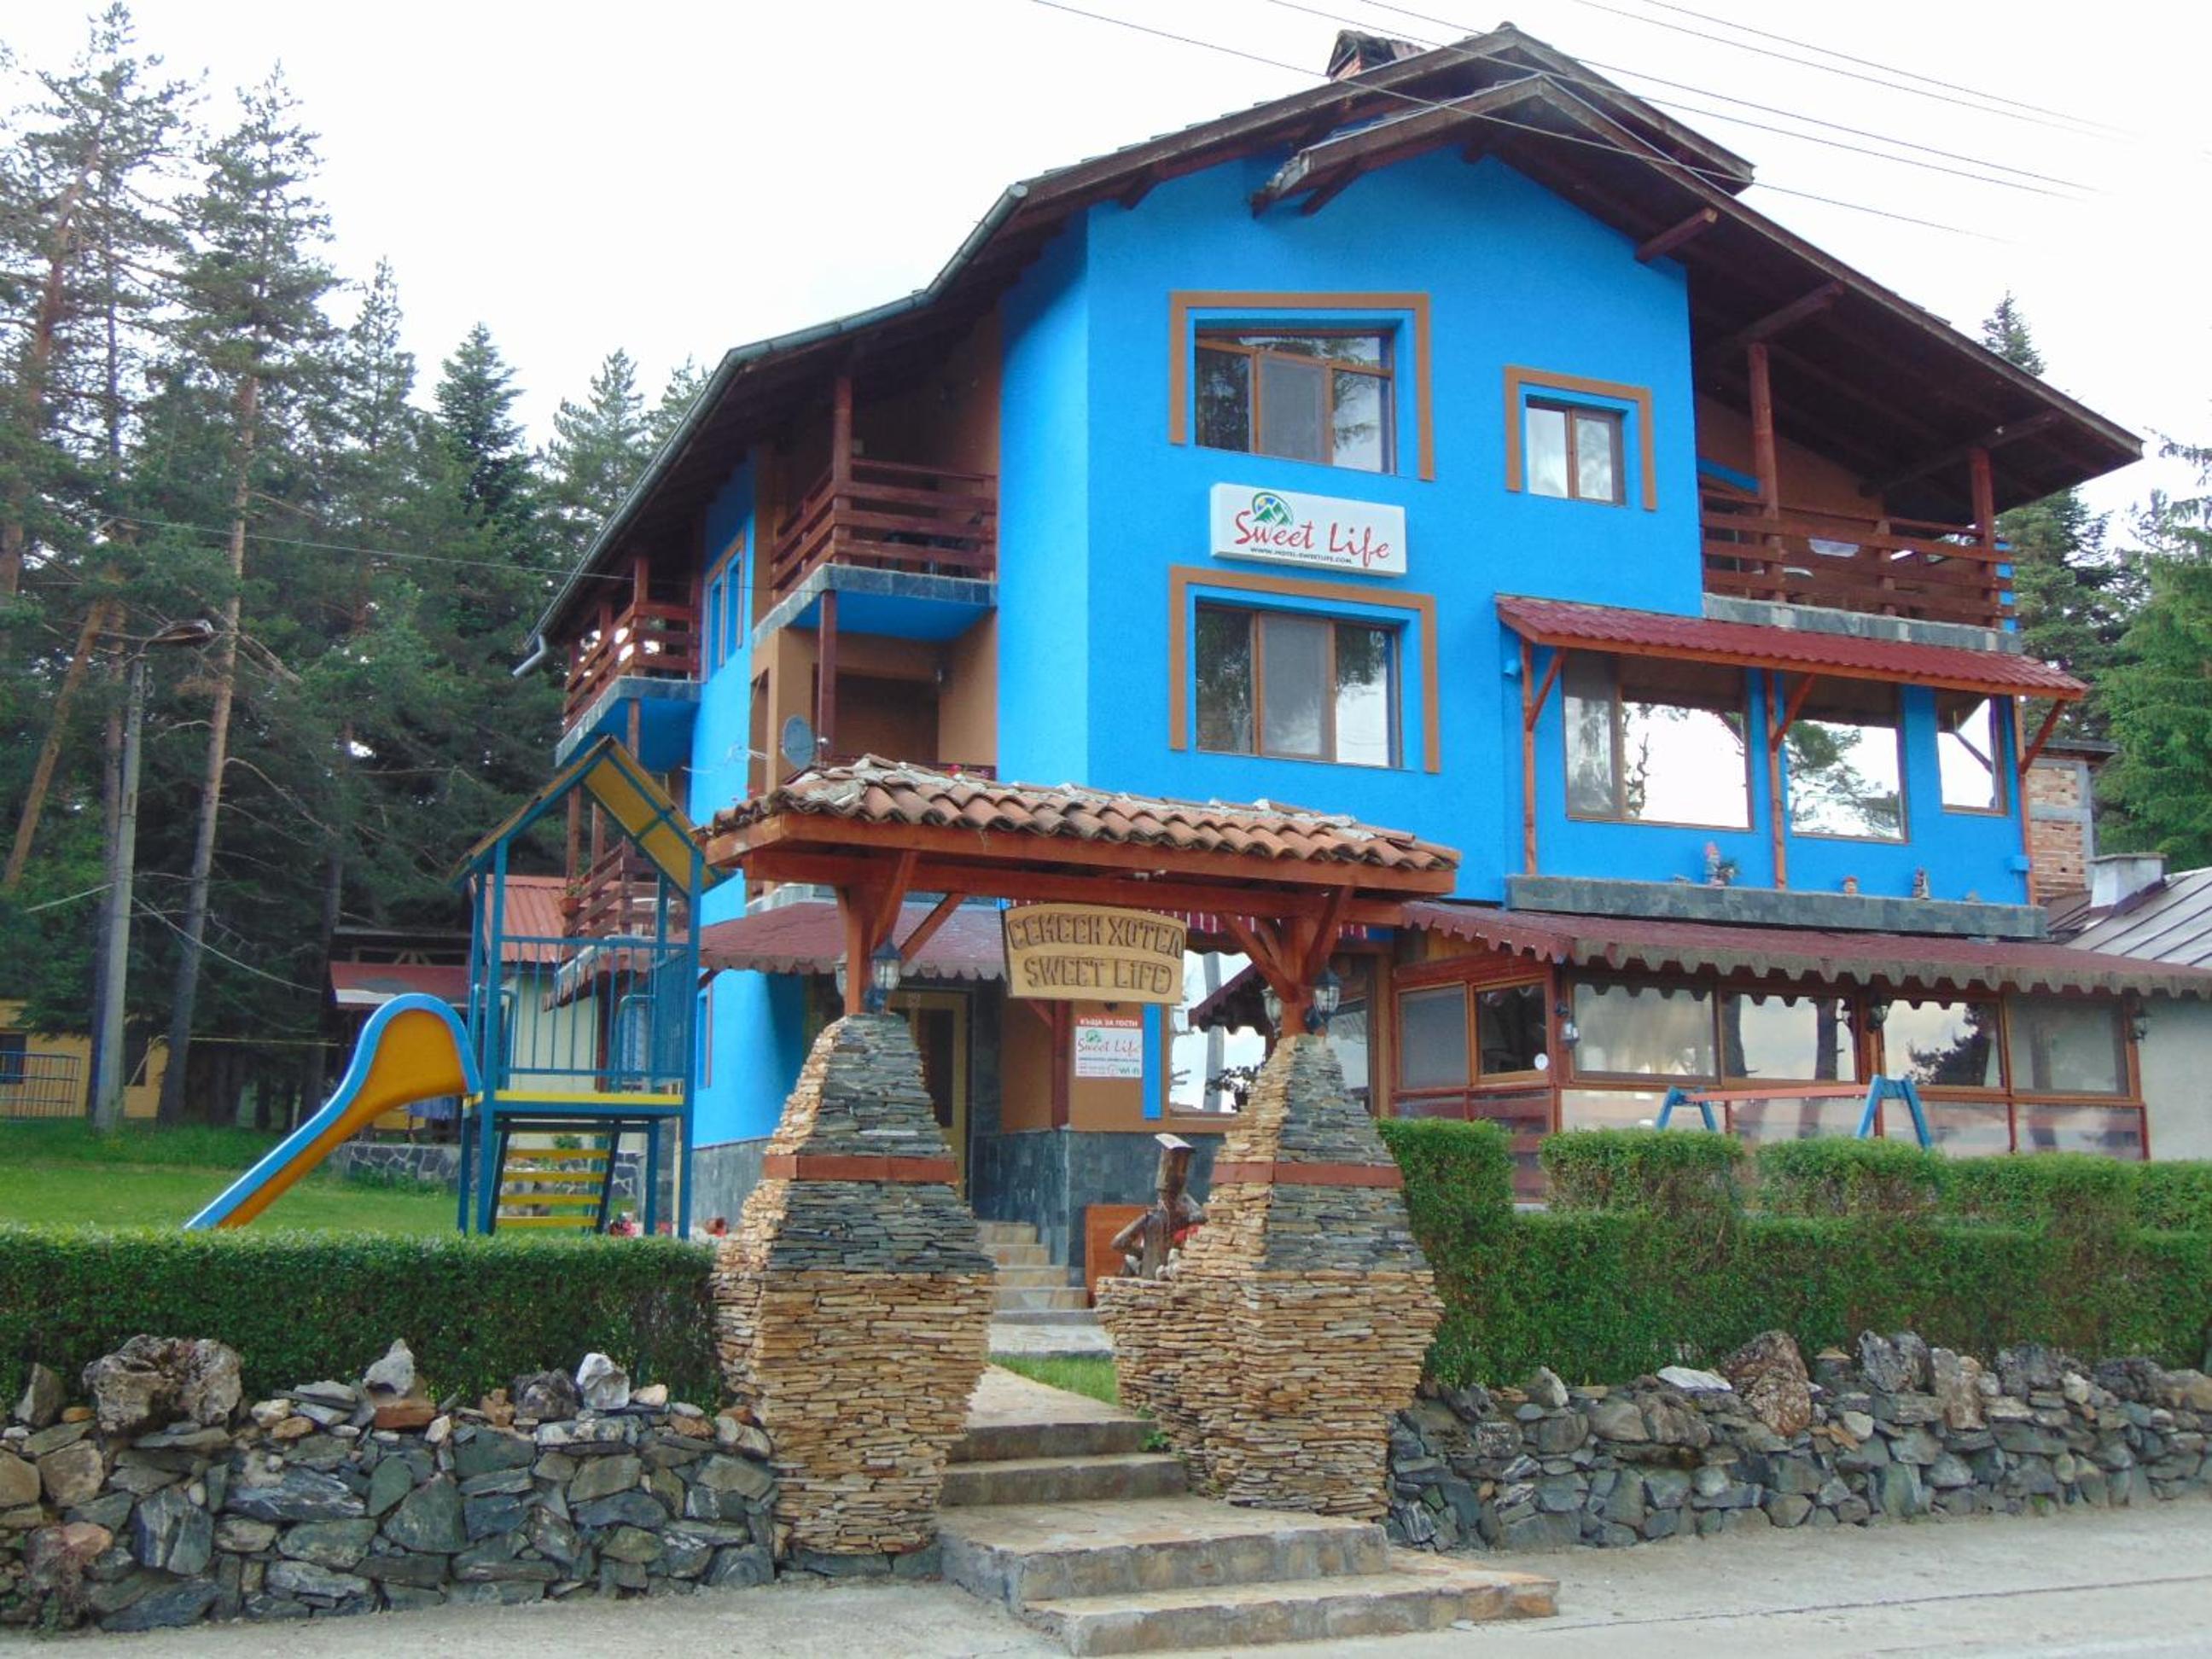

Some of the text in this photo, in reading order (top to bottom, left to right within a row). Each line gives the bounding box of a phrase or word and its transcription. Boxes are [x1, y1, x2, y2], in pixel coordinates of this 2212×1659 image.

[1234, 510, 1391, 568] Sweet Life
[1008, 913, 1185, 960] СЕМЕЕН ХОТЕЛ
[1024, 955, 1105, 988] SWEET
[1077, 1038, 1140, 1057] Sweet Life
